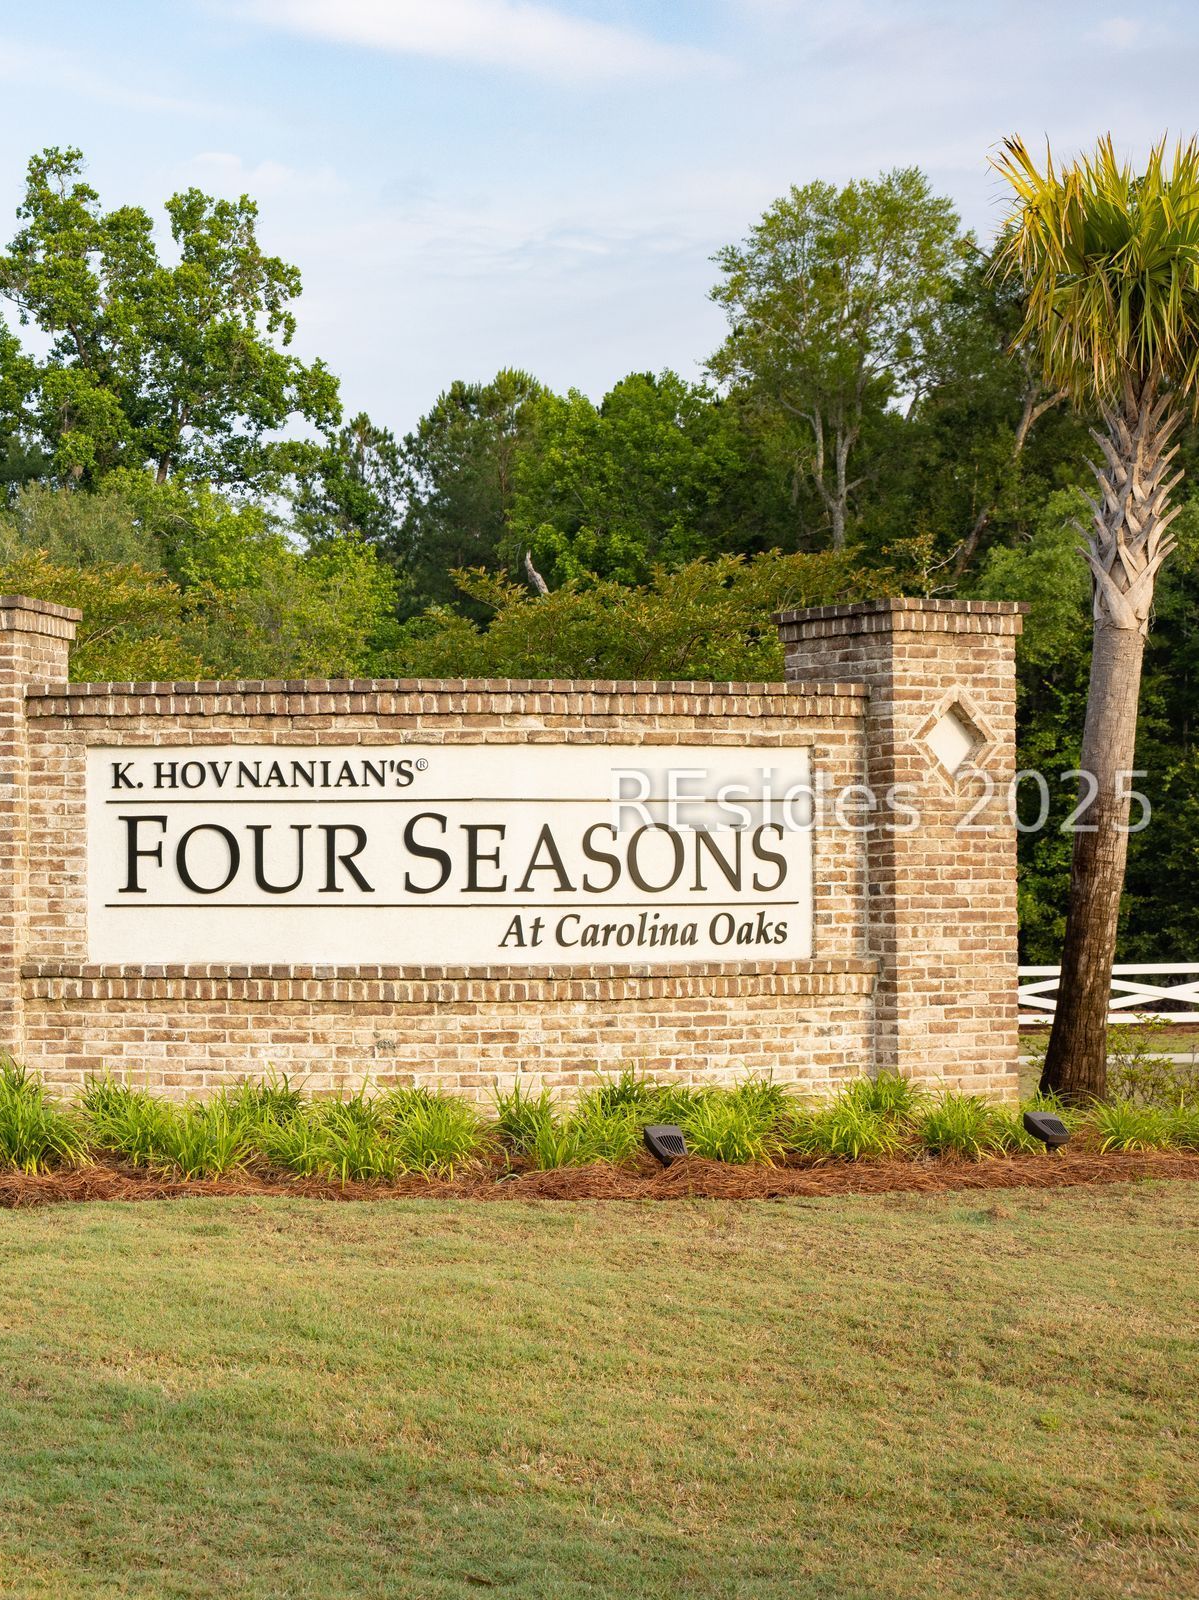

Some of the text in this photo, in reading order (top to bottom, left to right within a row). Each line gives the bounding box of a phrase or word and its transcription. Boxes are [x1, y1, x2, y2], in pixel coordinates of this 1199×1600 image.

[111, 762, 144, 789] K.
[118, 812, 788, 894] FOUR SEASONS
[498, 911, 788, 948] At Carolina Oaks
